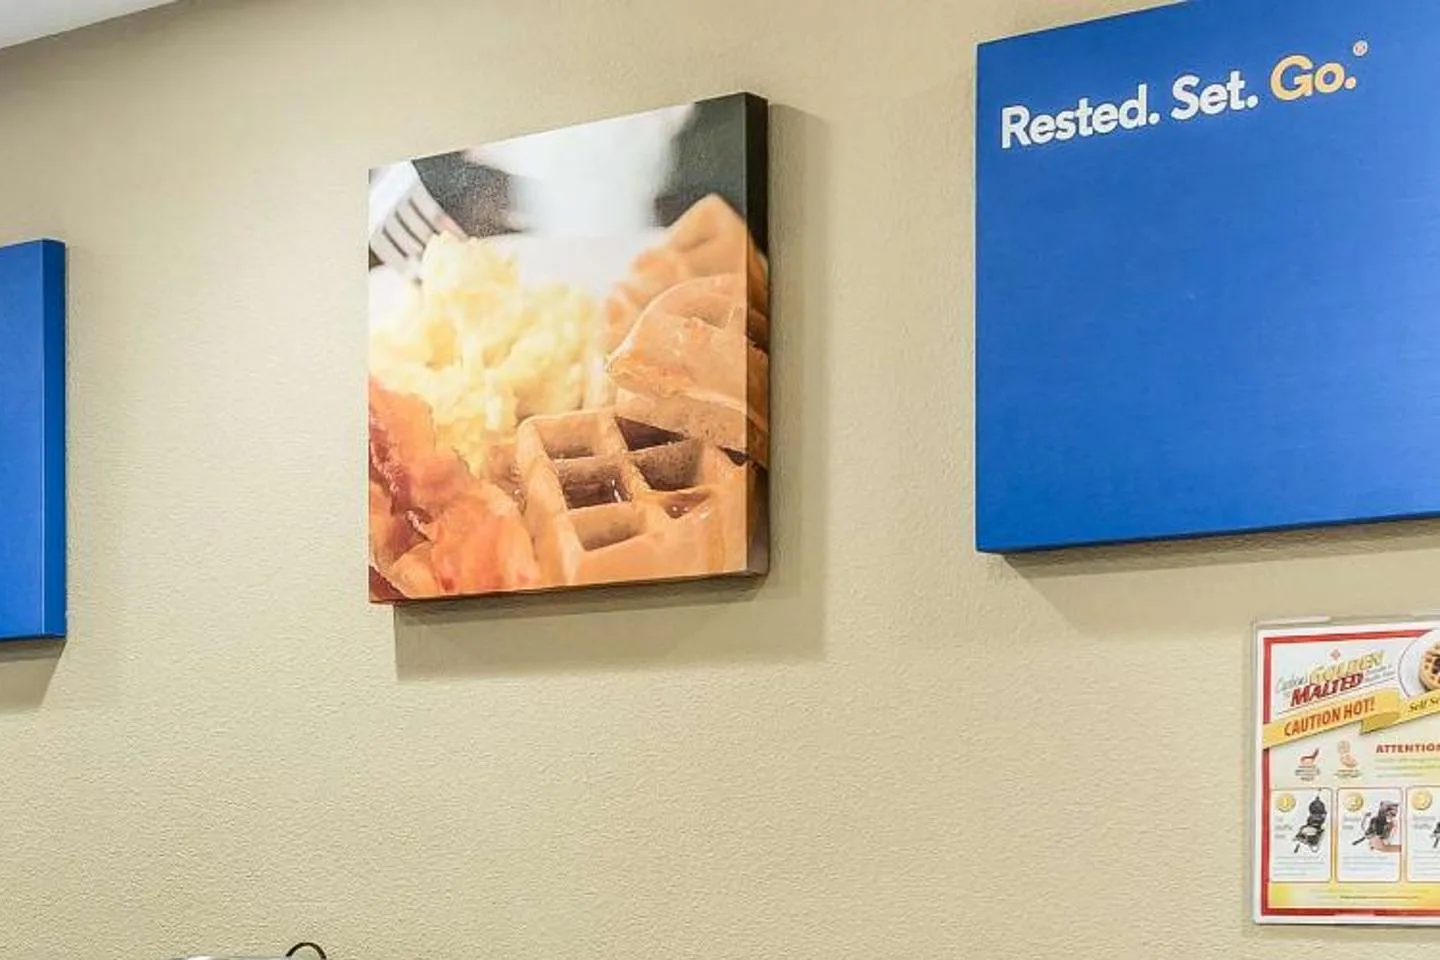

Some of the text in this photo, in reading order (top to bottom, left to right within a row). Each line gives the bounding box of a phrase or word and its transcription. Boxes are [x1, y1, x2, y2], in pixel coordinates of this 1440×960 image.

[1001, 84, 1160, 149] Rested.
[1171, 70, 1259, 121] Set.
[1290, 672, 1364, 707] MALTED
[1283, 696, 1376, 737] CAUTION HOT!
